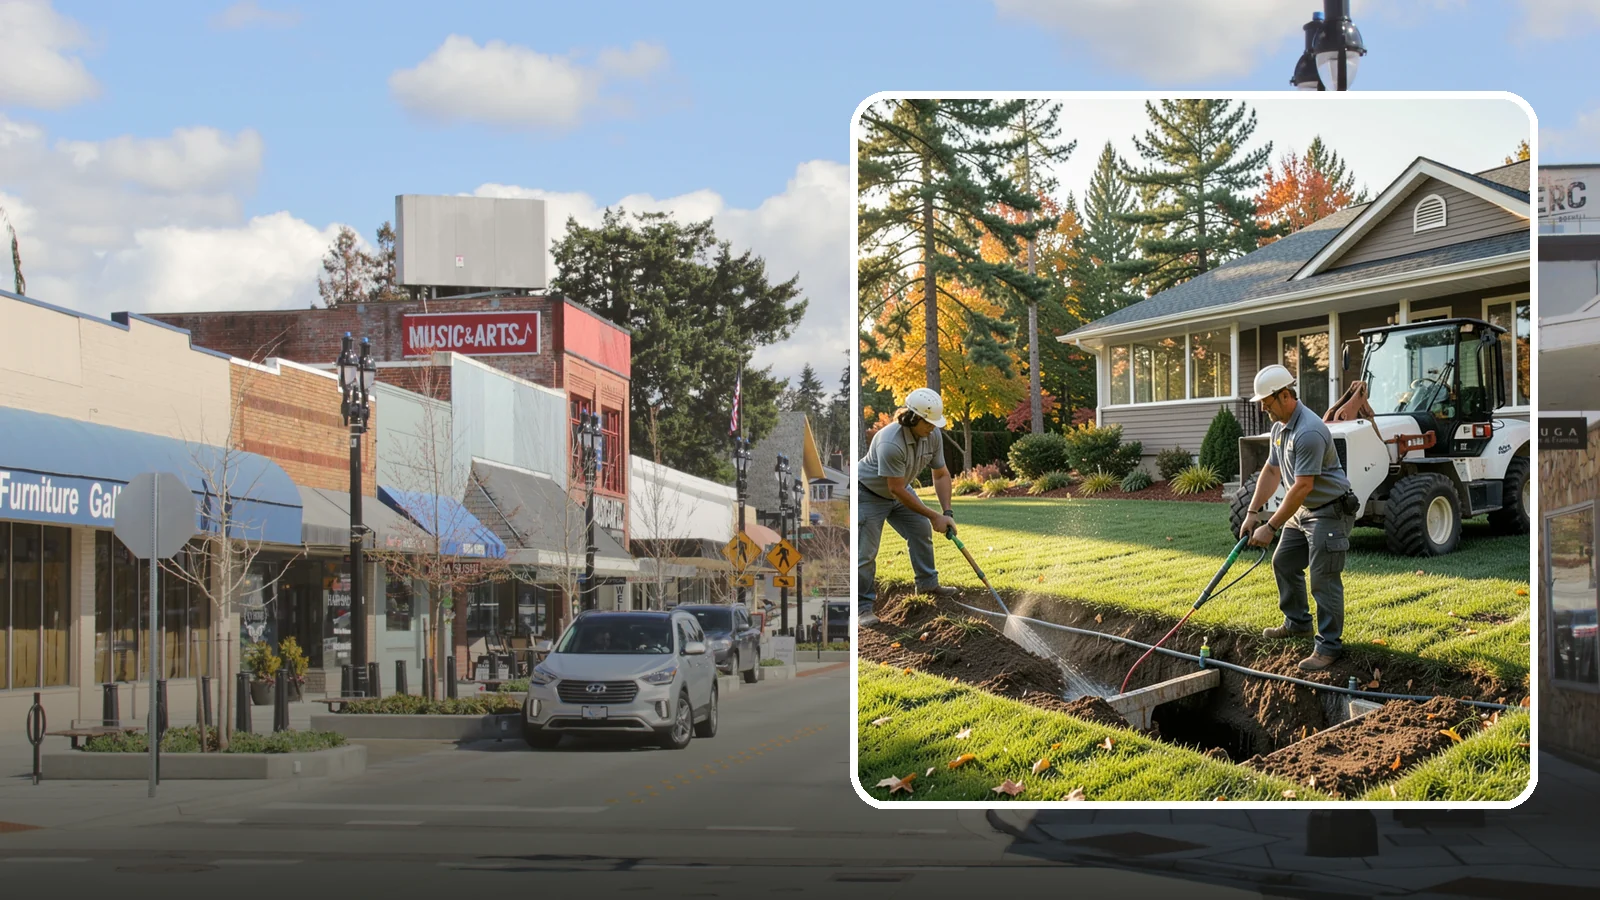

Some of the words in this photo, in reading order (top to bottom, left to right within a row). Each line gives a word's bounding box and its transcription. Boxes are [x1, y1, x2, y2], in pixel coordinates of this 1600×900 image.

[0, 471, 80, 516] Furniture
[89, 482, 122, 519] Gal
[453, 563, 479, 574] SUSHI
